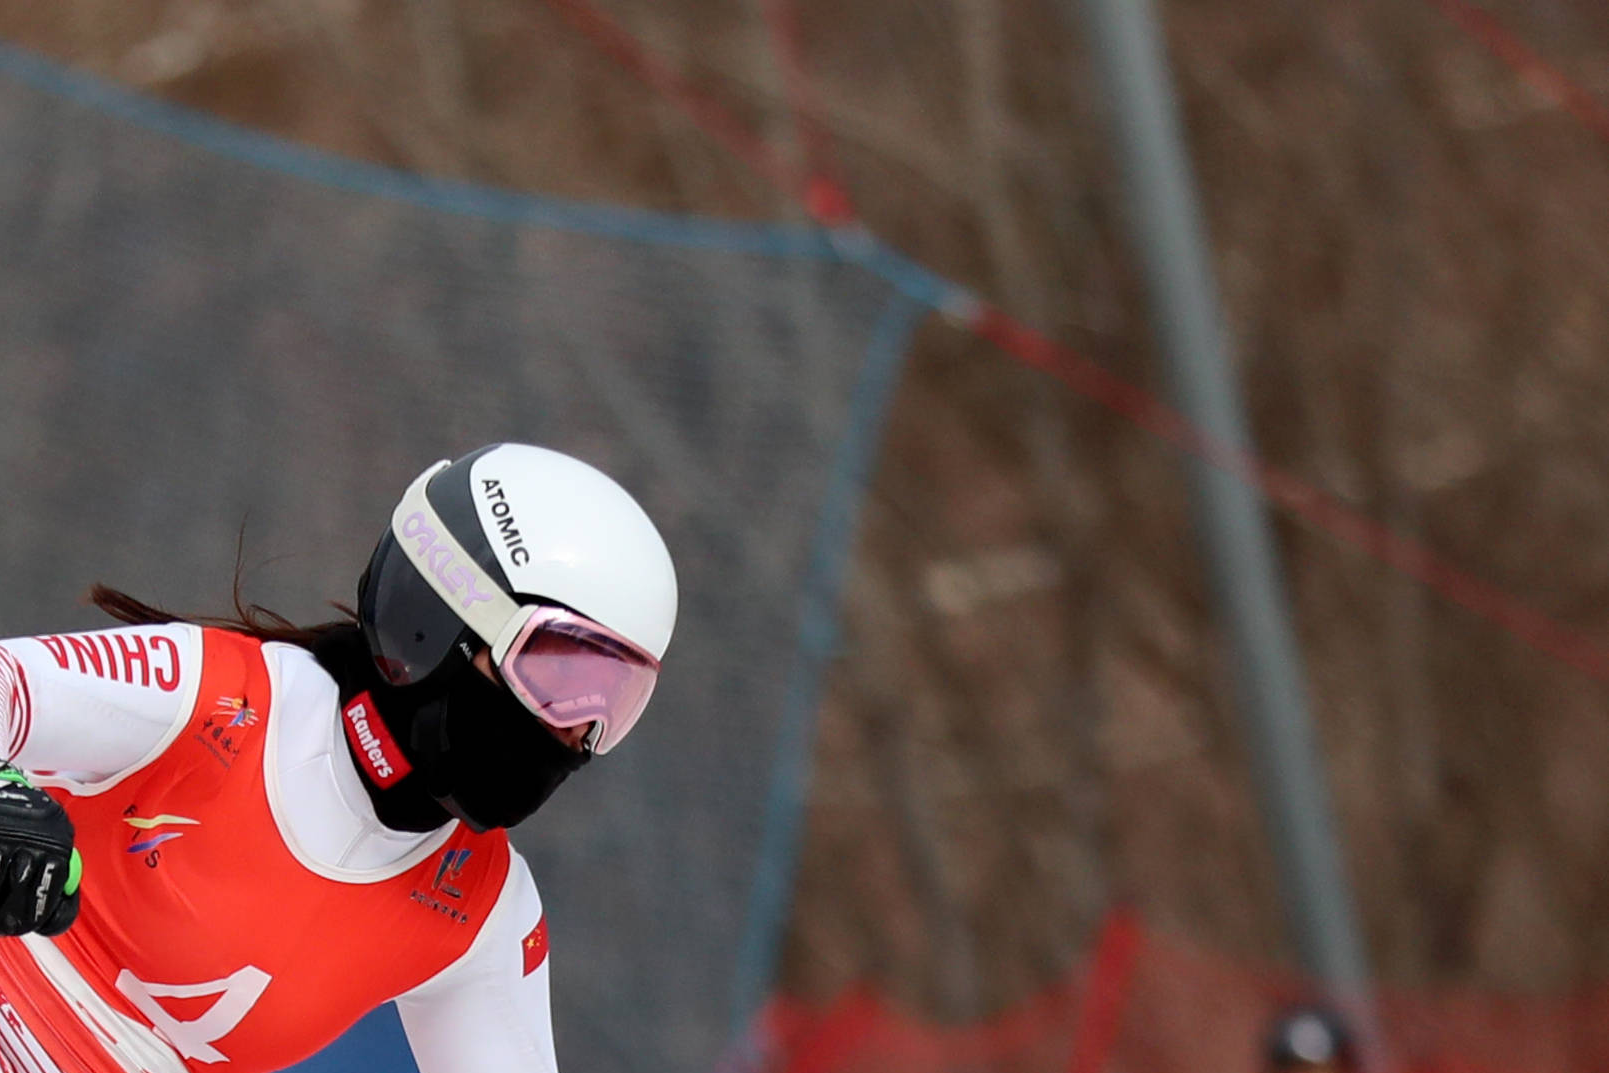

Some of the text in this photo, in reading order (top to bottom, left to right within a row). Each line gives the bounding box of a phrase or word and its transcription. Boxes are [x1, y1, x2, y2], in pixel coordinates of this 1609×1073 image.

[401, 511, 494, 610] OAKLEY
[481, 478, 530, 568] ATOMIC
[31, 634, 181, 692] CHINA
[347, 703, 394, 778] Ranters
[34, 862, 56, 922] LEVEL
[115, 964, 272, 1064] 4
